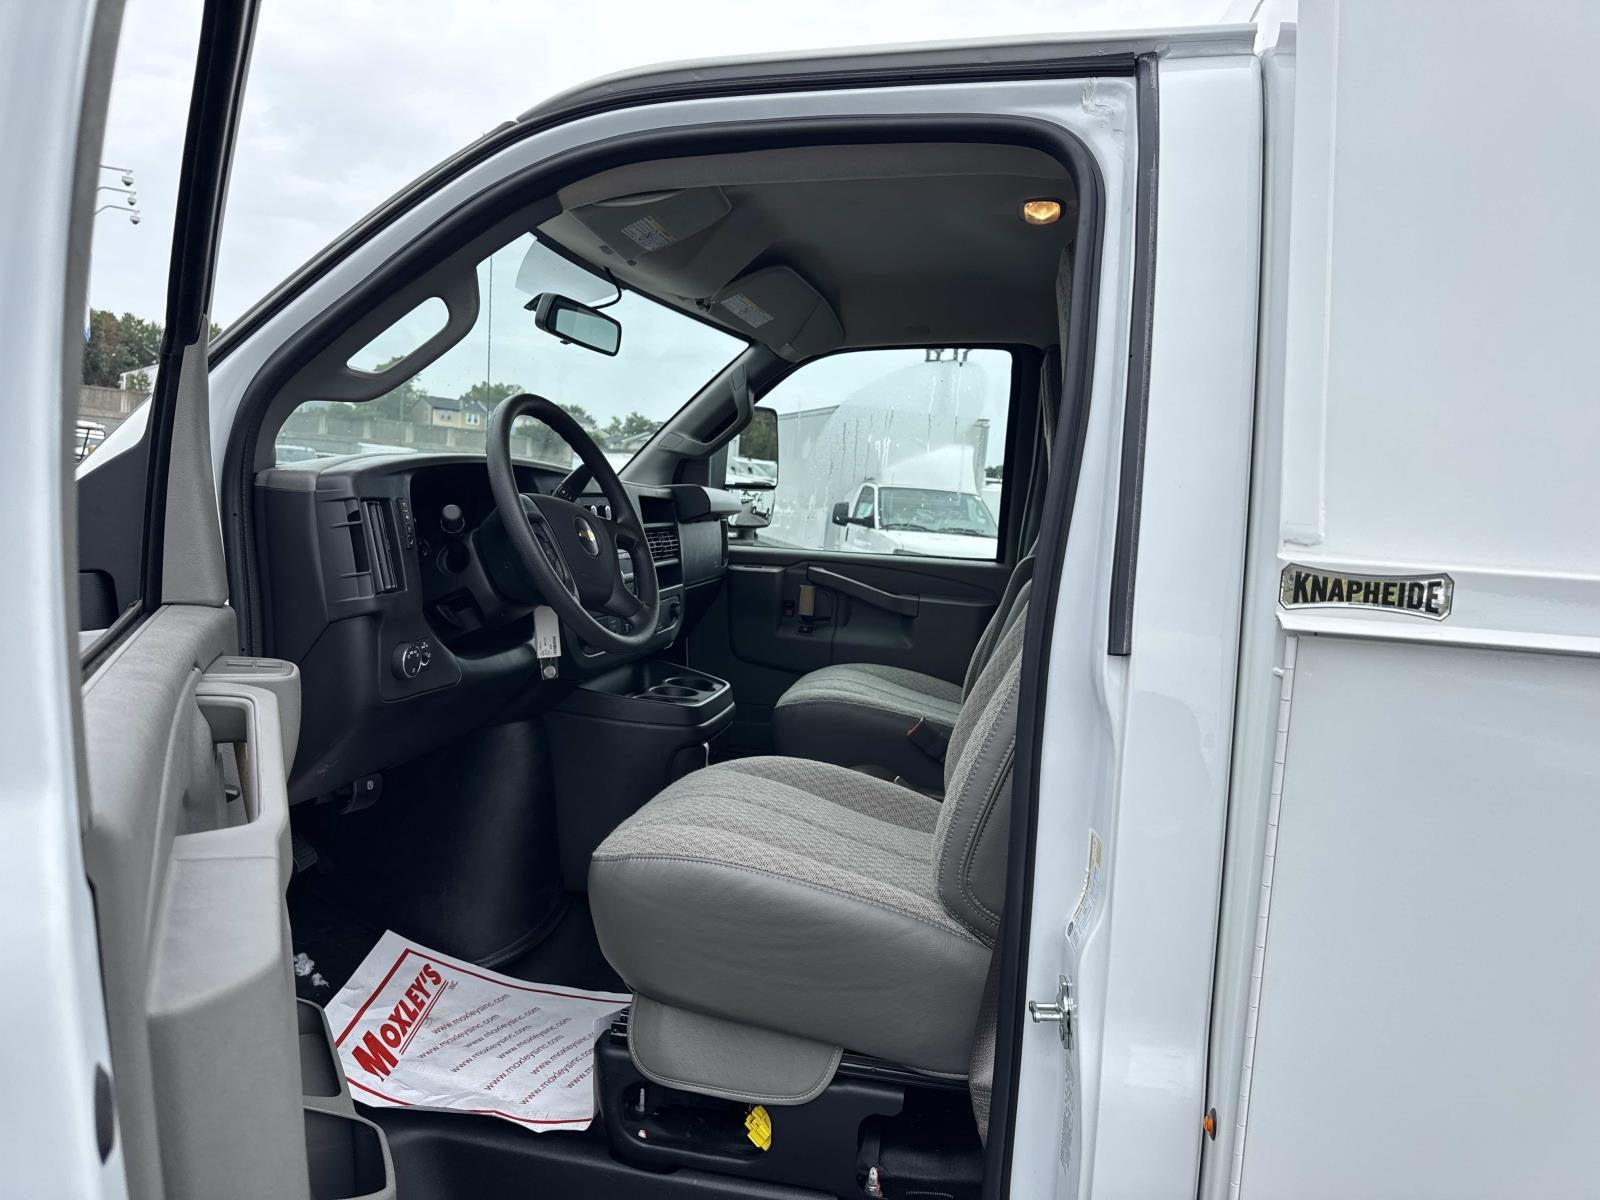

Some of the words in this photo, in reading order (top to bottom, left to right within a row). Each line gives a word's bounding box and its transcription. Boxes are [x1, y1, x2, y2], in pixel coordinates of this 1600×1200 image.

[1292, 570, 1442, 614] KNAPHEIDE
[352, 963, 442, 1082] MOXLEY'S
[432, 993, 511, 1035] www.moxleysinc.com
[464, 1006, 542, 1048] www.moxleysinc.com
[417, 1014, 501, 1059] www.moxleysinc.com
[450, 1025, 533, 1073] www.moxleysinc.com
[497, 1017, 573, 1060] www.moxleysinc.com
[484, 1035, 565, 1091] www.moxleysinc.com
